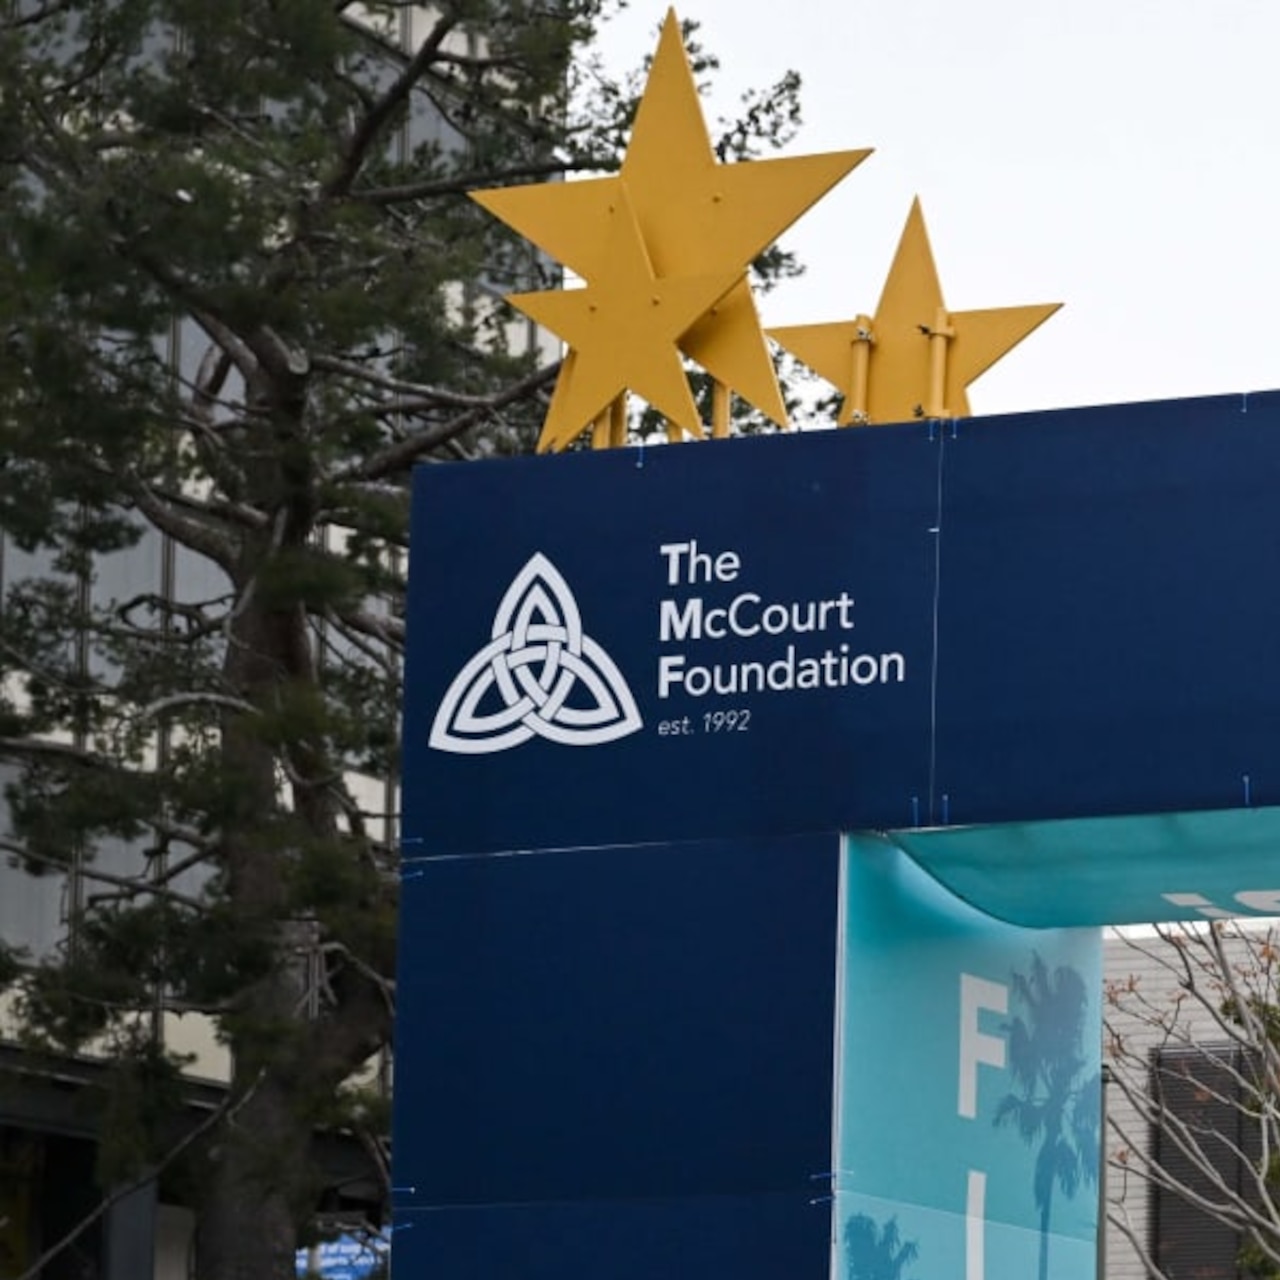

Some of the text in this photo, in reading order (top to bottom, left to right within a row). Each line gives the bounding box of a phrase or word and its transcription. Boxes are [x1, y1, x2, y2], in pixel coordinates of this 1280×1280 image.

[660, 540, 741, 586] The
[659, 593, 854, 642] McCourt
[659, 645, 905, 698] Foundation
[658, 709, 752, 736] est. 1992
